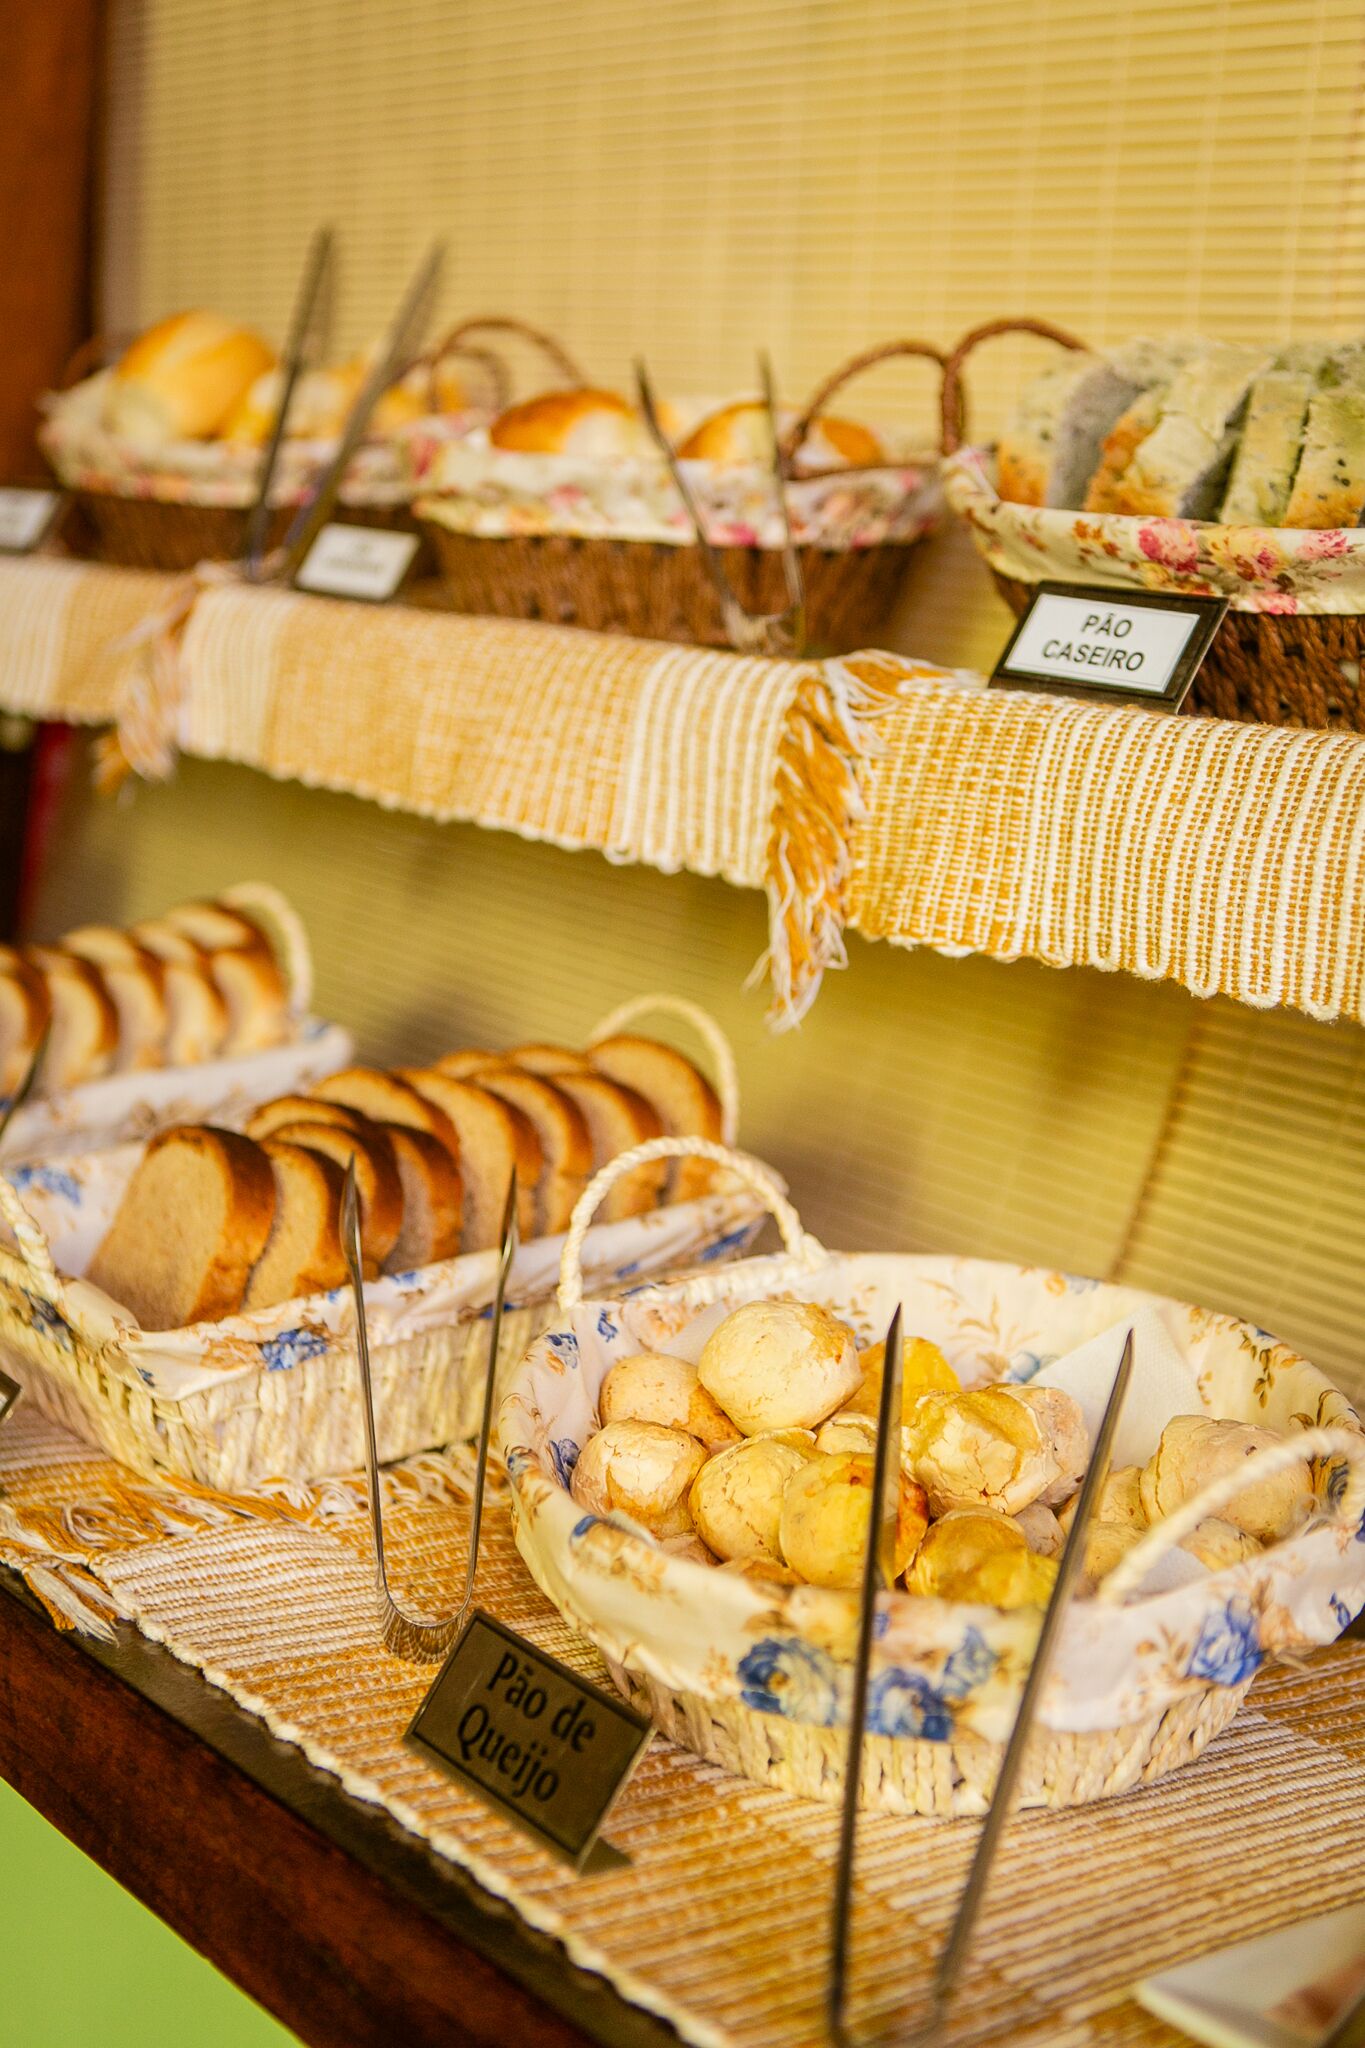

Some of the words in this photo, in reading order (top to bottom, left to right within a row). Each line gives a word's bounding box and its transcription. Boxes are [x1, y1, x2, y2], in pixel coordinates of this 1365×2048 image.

[1042, 640, 1145, 671] CASEIRO
[1081, 612, 1133, 638] PÃO
[486, 1651, 548, 1719] Pão
[551, 1700, 596, 1752] de
[456, 1704, 559, 1801] Queijo
